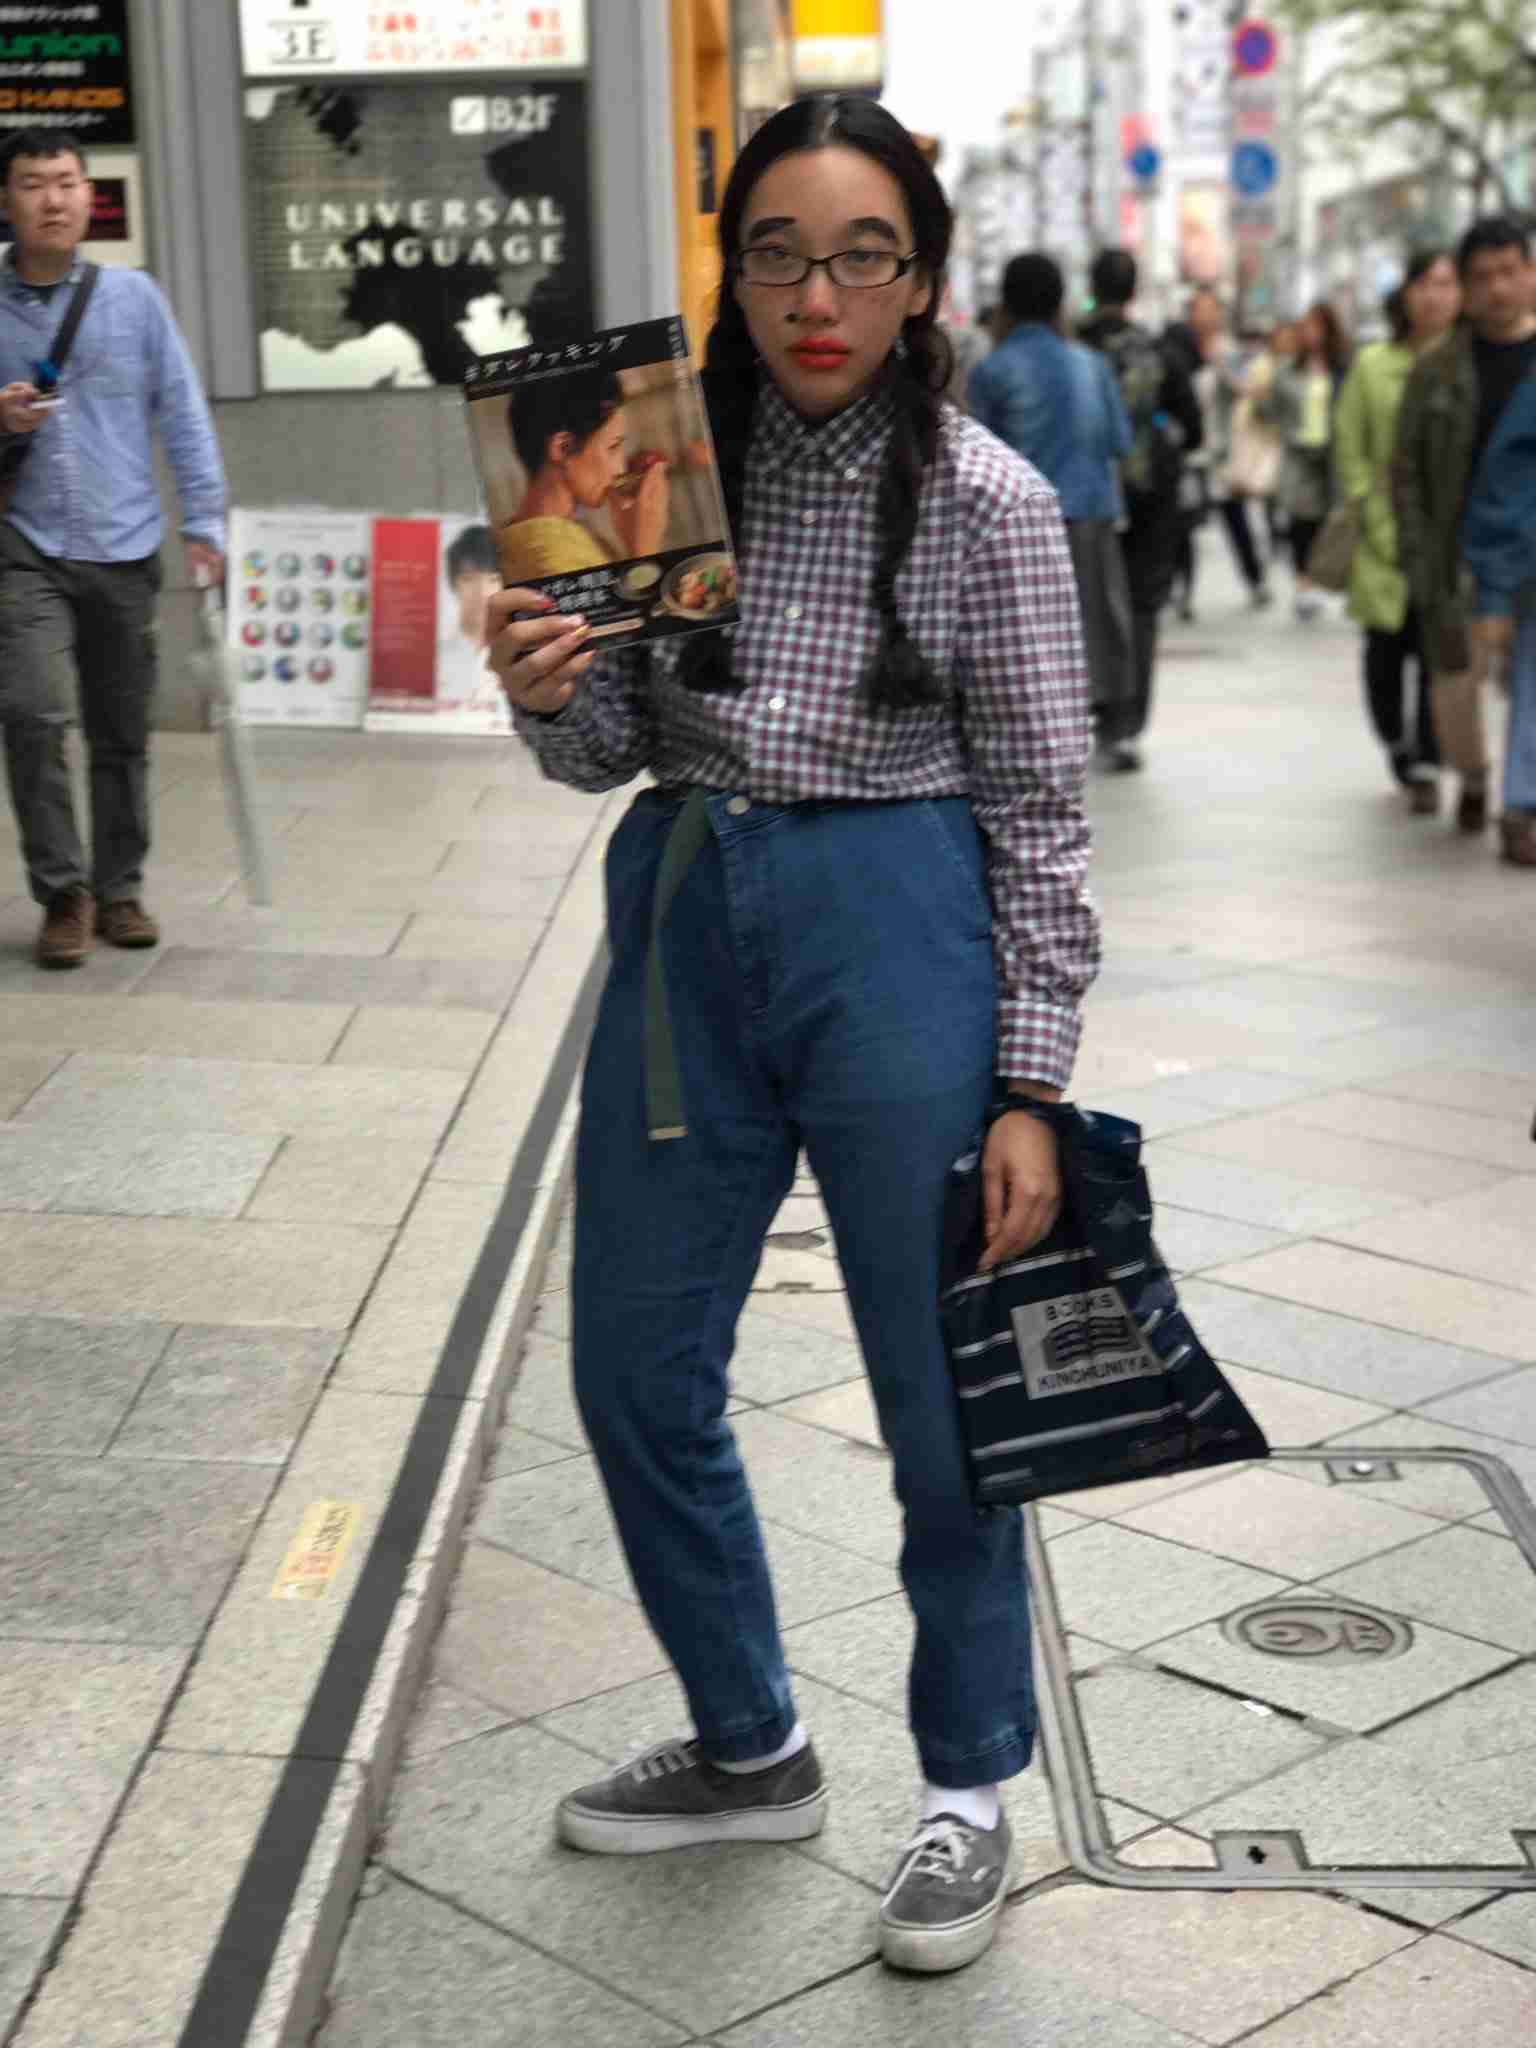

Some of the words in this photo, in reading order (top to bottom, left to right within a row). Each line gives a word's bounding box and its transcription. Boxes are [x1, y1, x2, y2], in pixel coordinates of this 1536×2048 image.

[488, 94, 558, 132] B2F
[285, 197, 563, 232] UNIVERSAL
[289, 233, 563, 271] LANGUAGE
[1046, 1290, 1115, 1321] BOOKS
